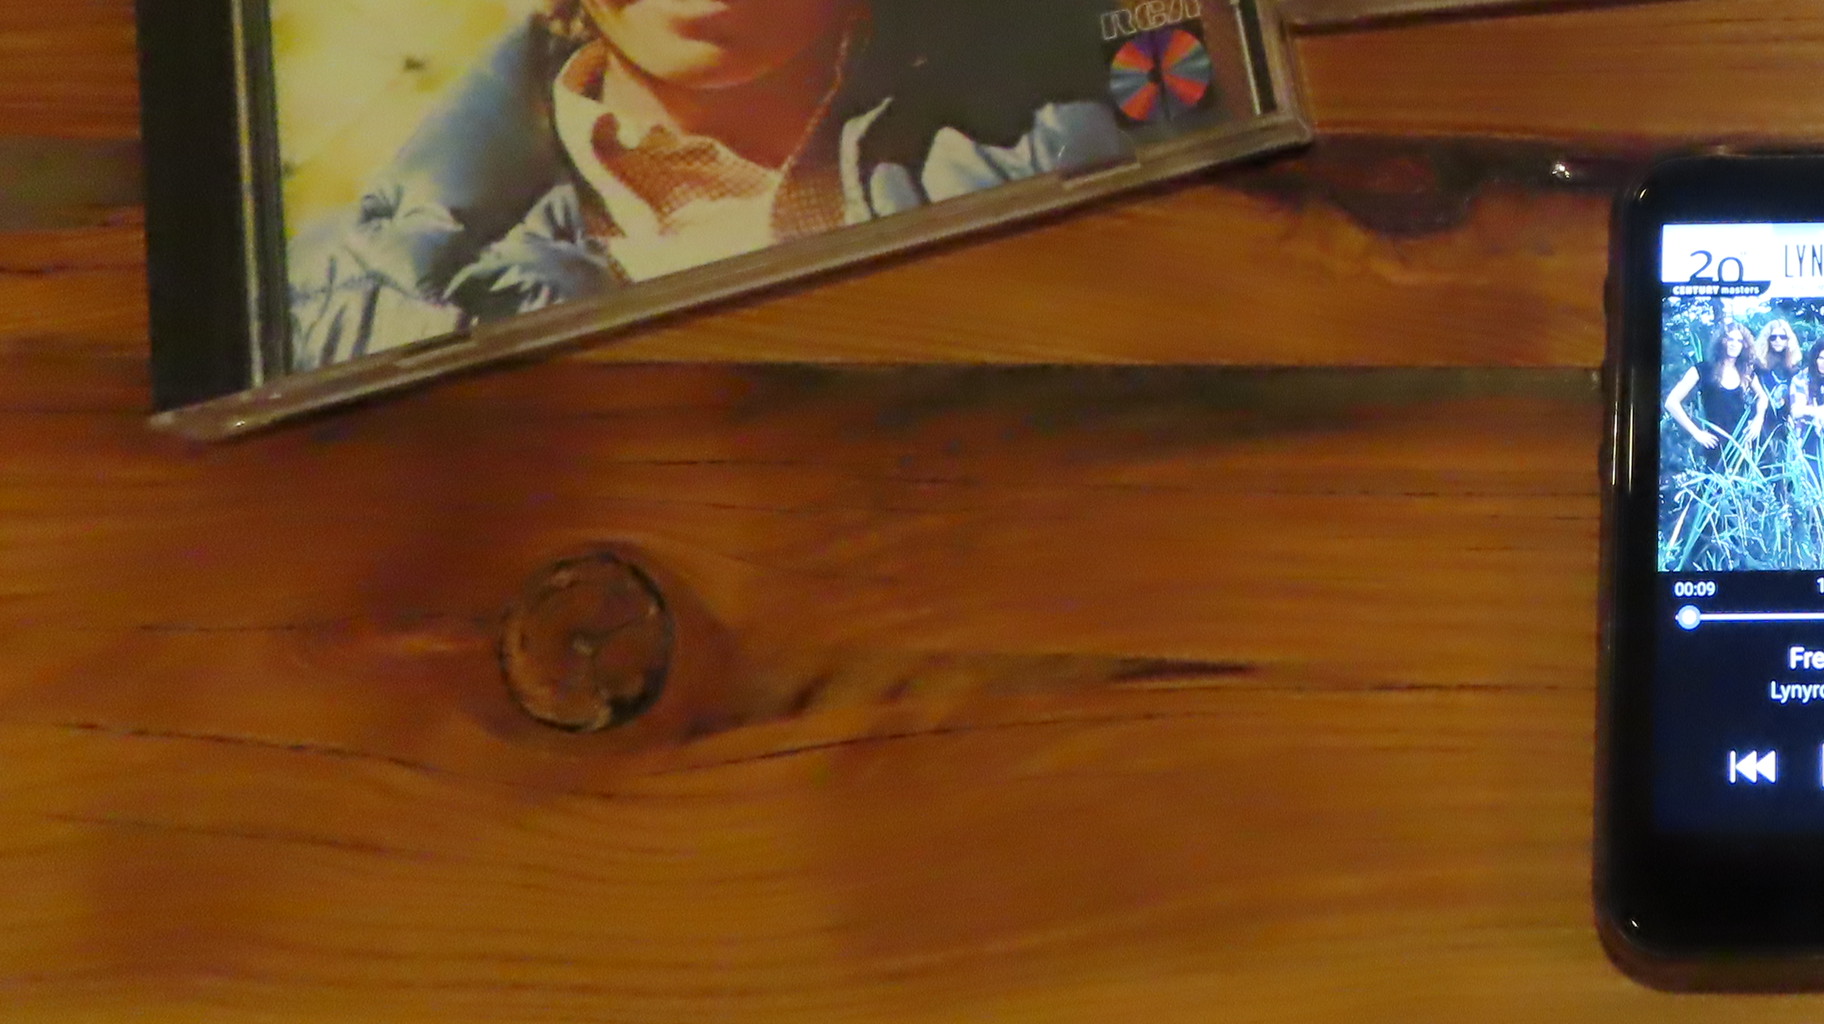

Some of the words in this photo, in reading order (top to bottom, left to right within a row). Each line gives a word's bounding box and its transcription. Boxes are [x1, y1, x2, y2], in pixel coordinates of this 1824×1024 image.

[1672, 284, 1720, 296] CENTURY
[1721, 285, 1761, 296] masters
[1674, 581, 1716, 597] 00:09
